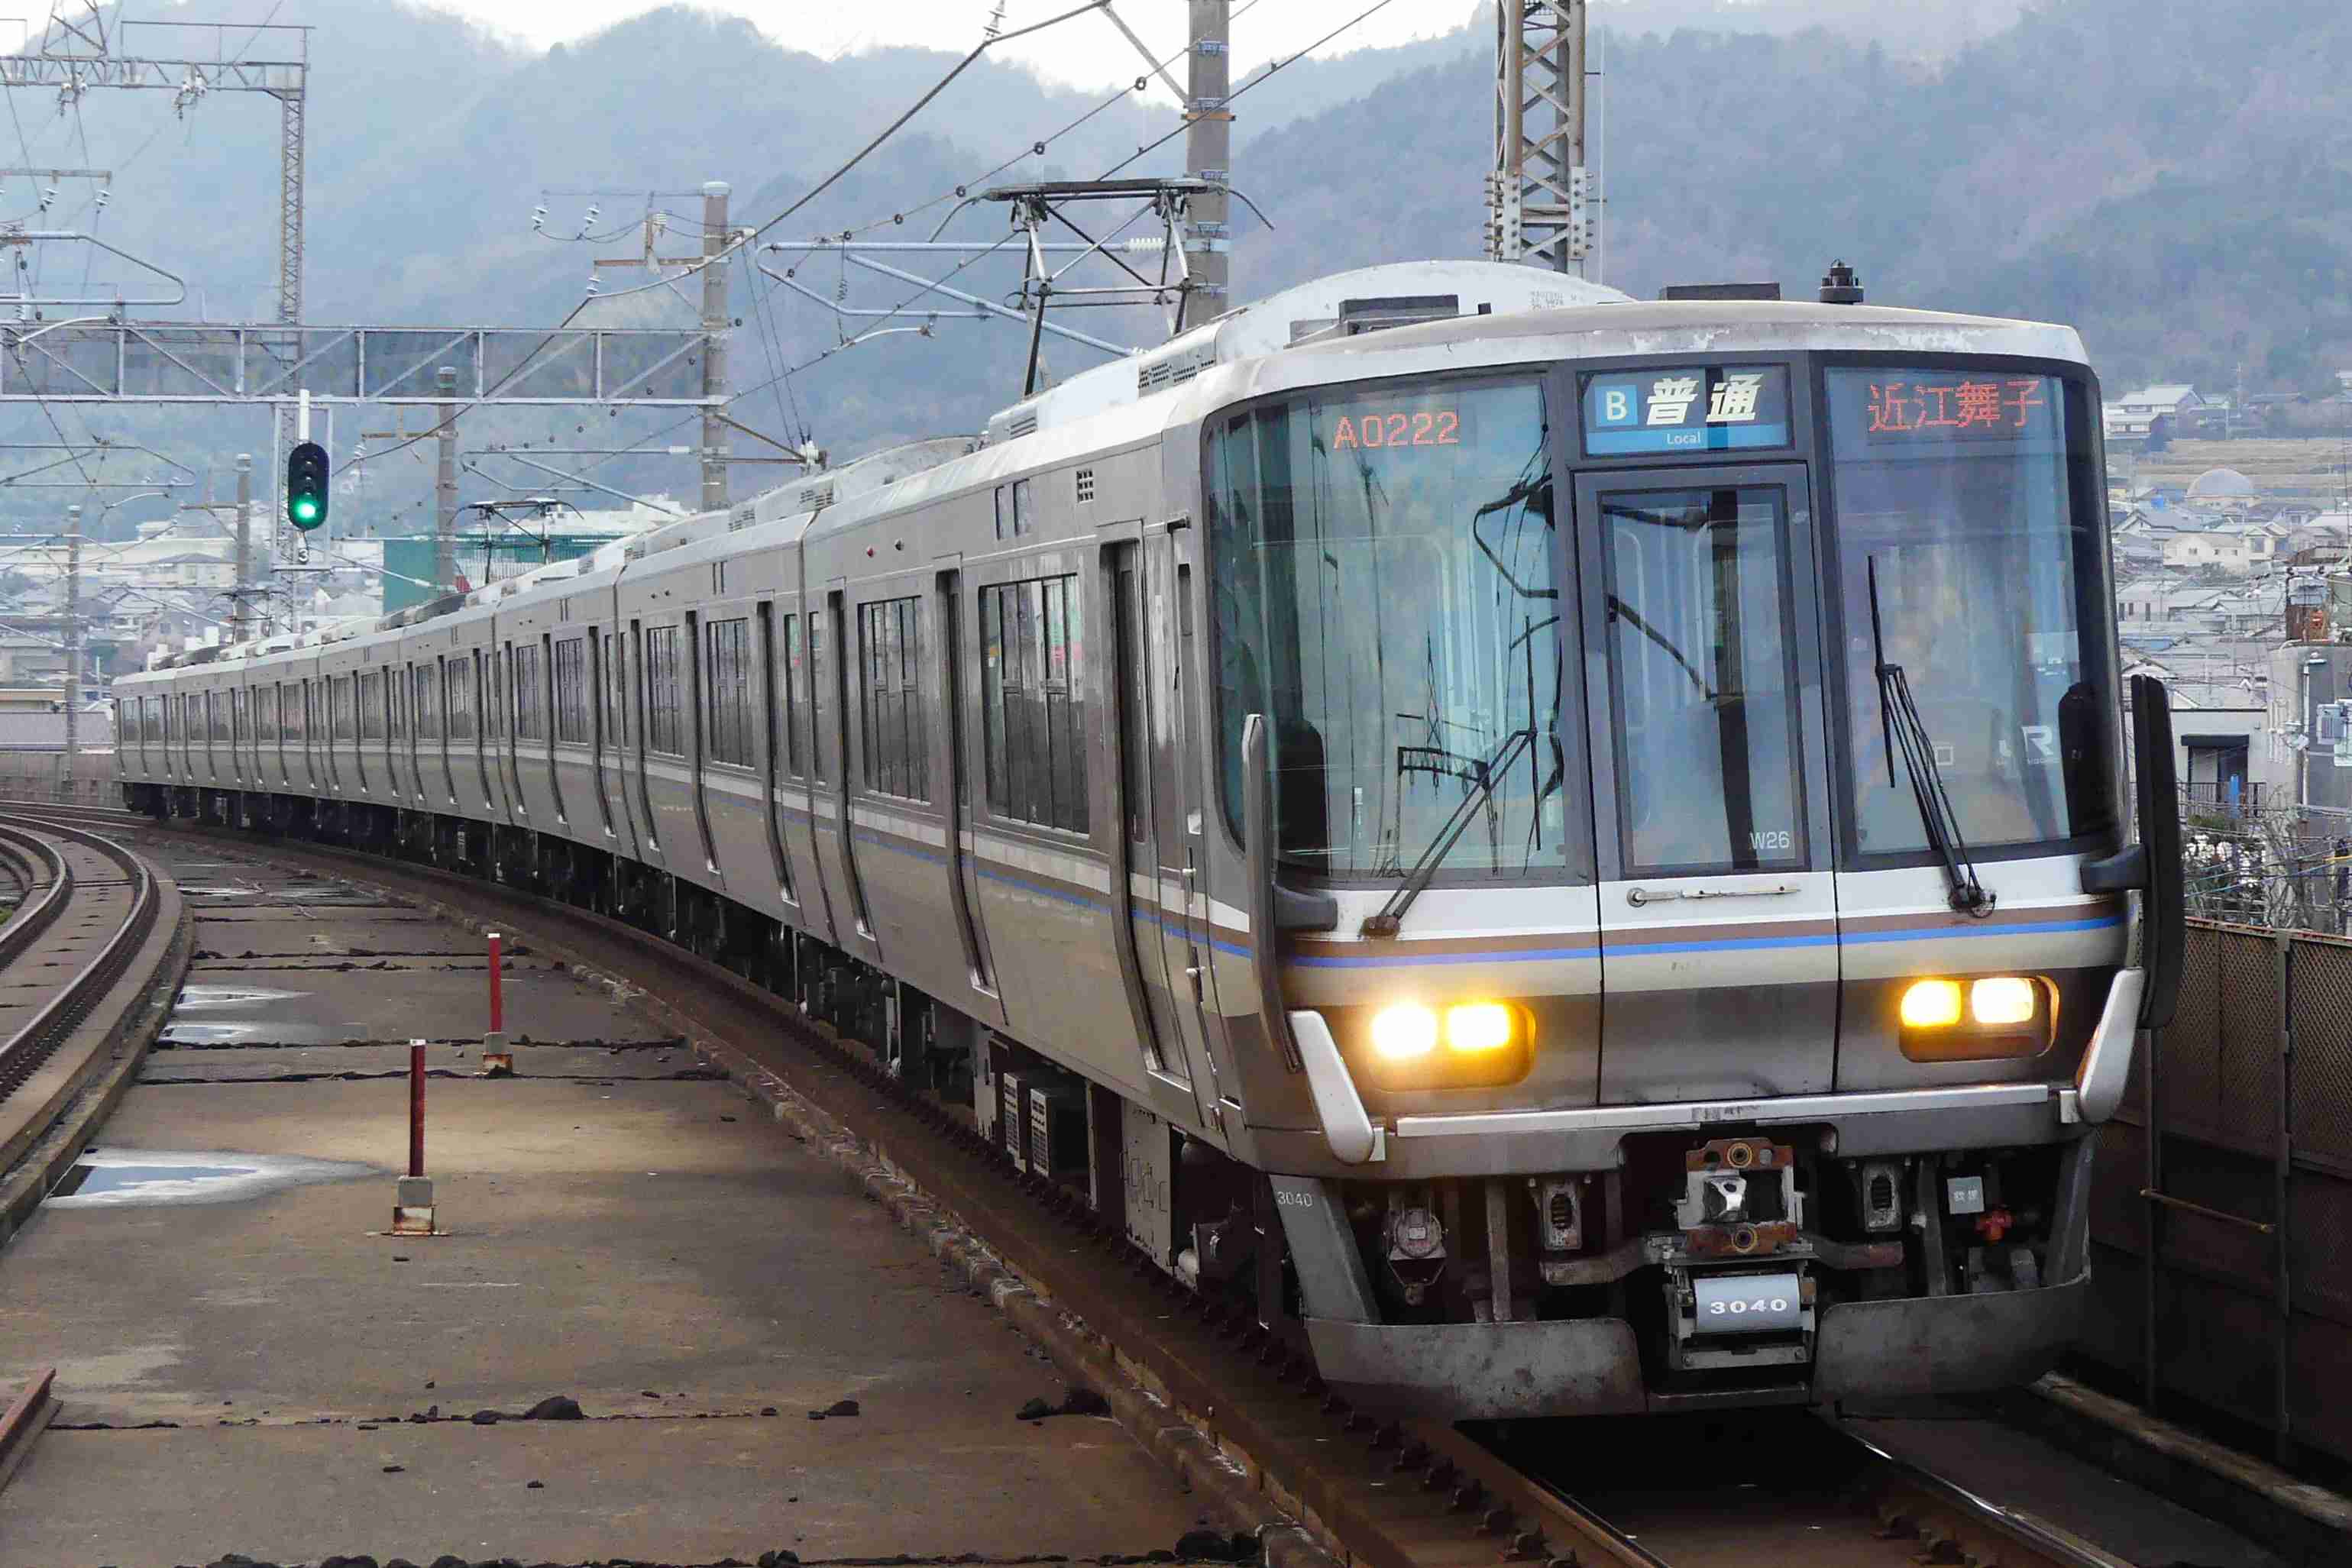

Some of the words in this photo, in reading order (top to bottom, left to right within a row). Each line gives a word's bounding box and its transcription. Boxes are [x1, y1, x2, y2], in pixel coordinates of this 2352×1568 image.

[1606, 390, 1627, 421] B
[1645, 373, 1762, 426] 普通
[1866, 379, 2043, 433] 近江舞子
[1333, 409, 1461, 451] A0222
[1667, 432, 1700, 445] Local
[299, 548, 308, 562] 3
[1749, 831, 1791, 850] W26
[1276, 1191, 1313, 1208] 3040
[1710, 1298, 1787, 1314] 3040
